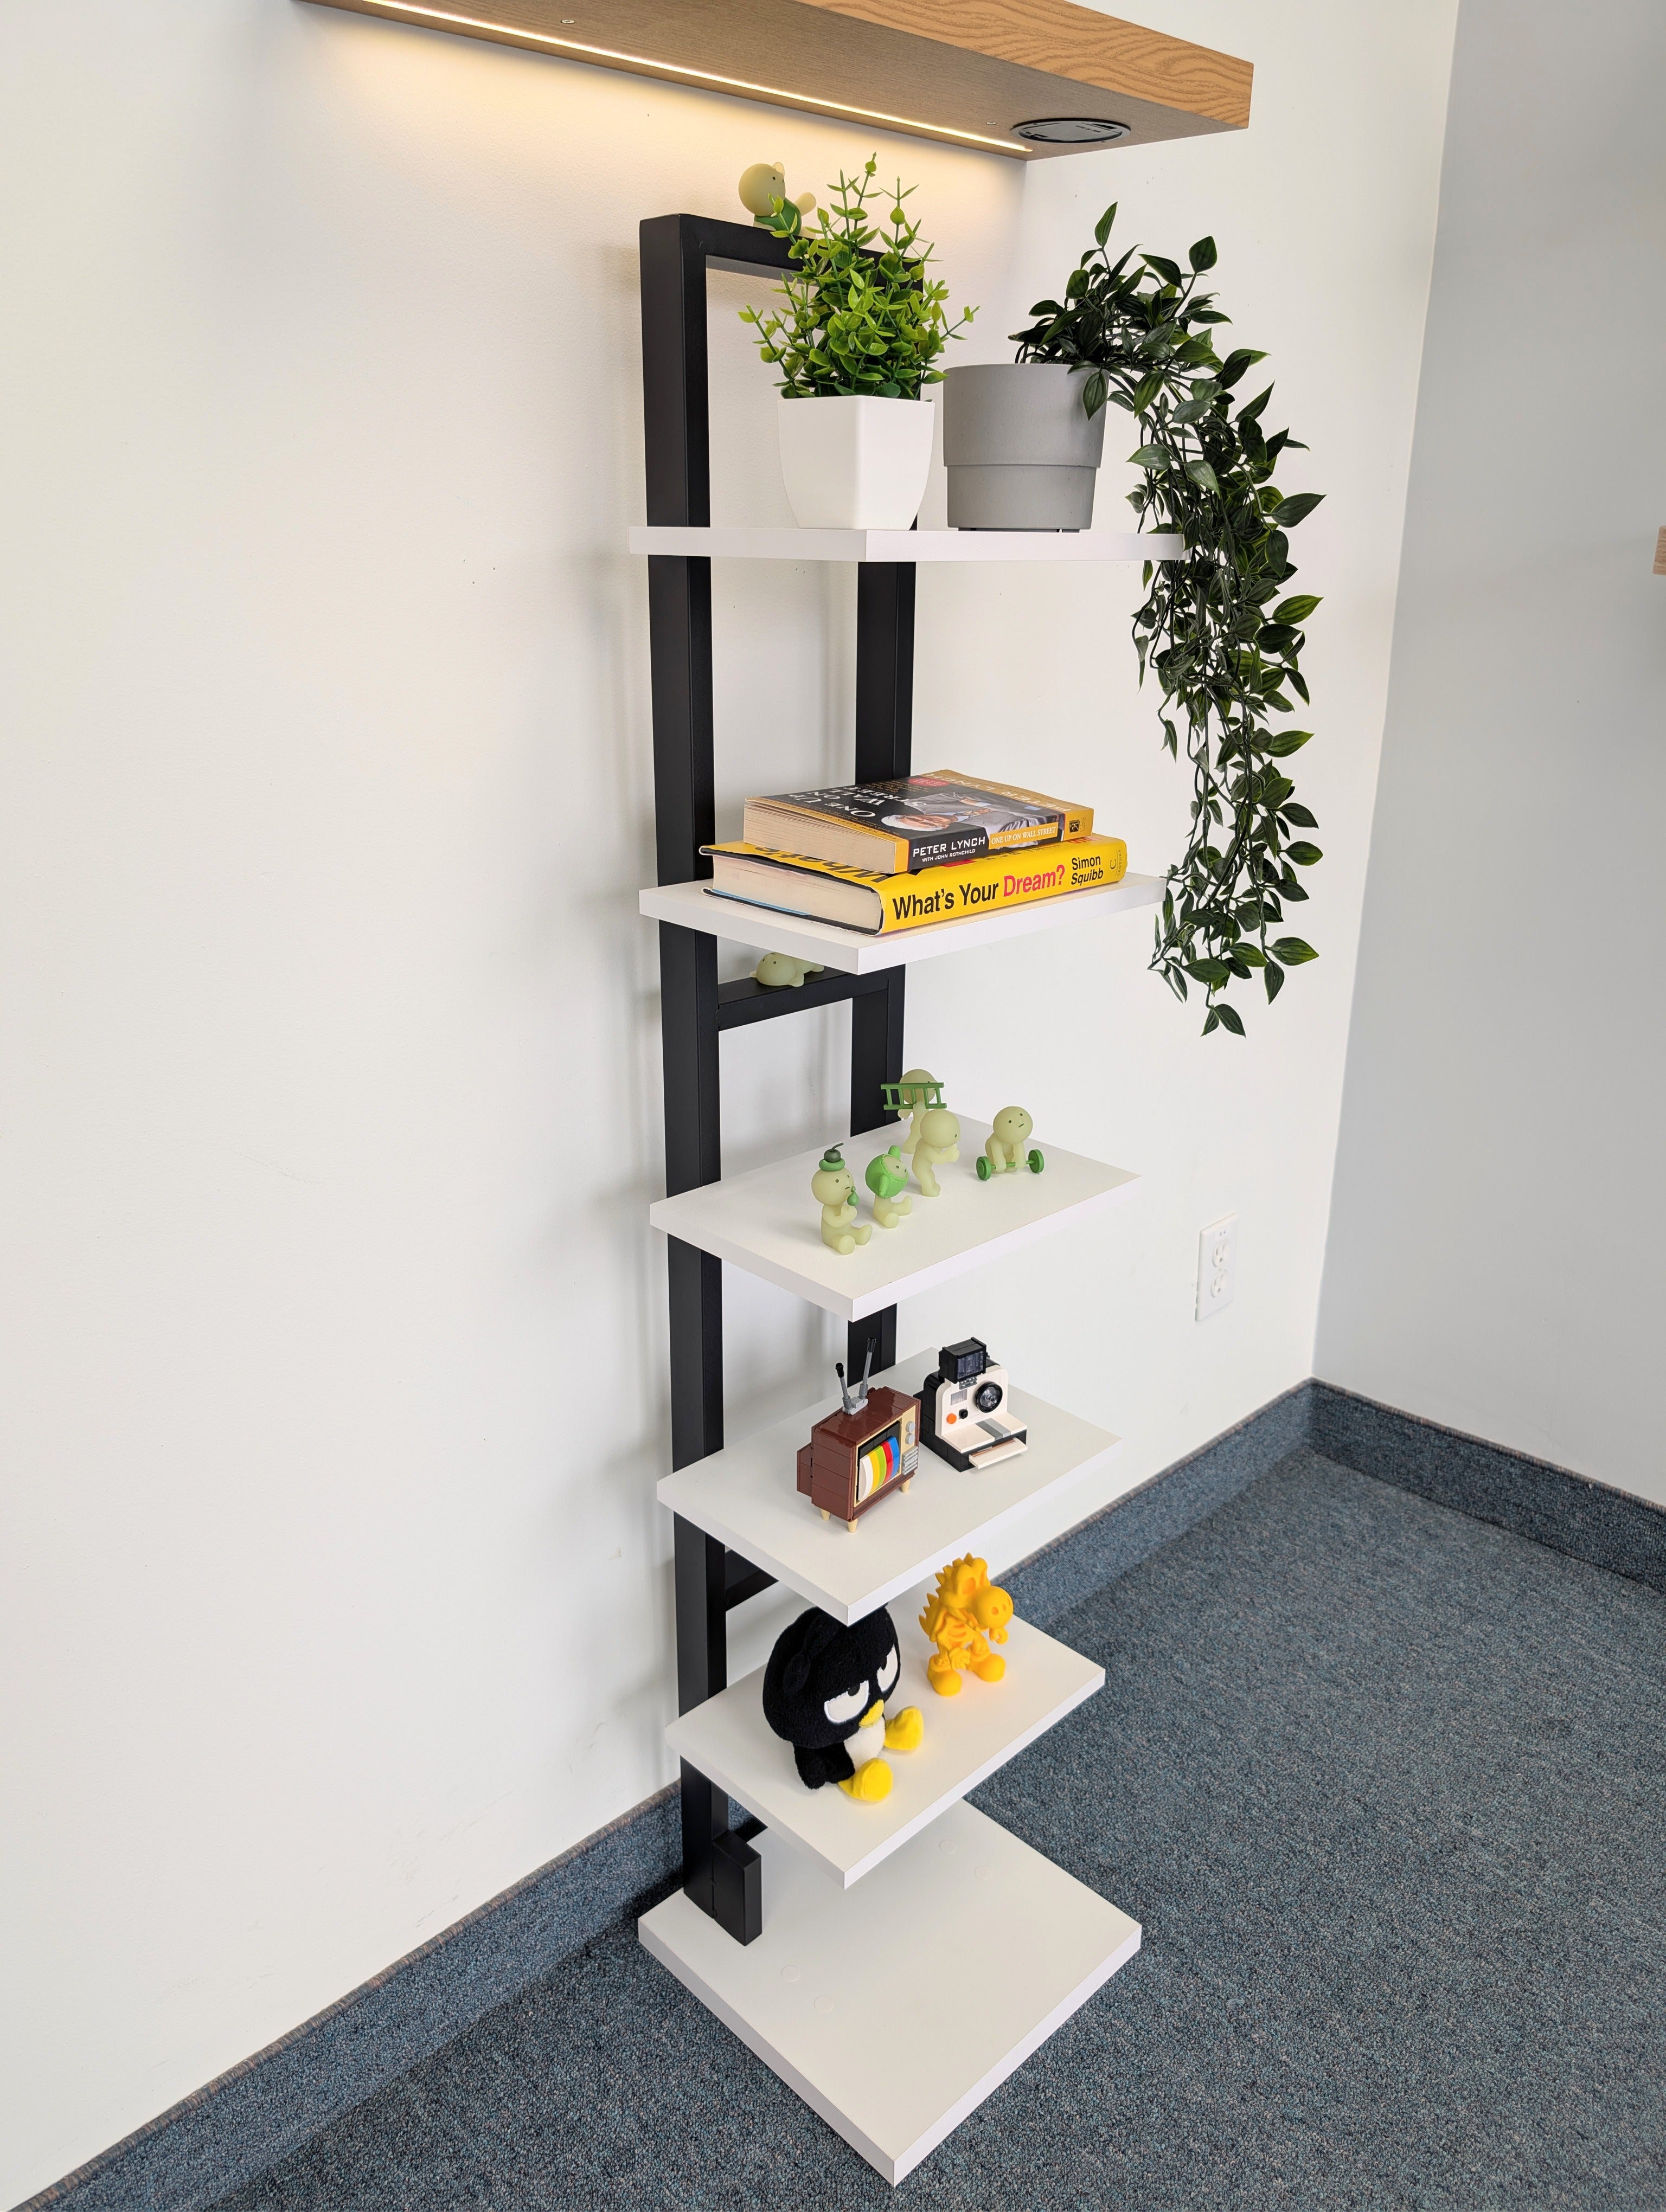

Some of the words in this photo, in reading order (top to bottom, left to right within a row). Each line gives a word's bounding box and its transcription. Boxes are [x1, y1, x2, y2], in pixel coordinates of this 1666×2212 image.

[924, 774, 995, 790] LYNCH
[789, 794, 822, 803] UP
[829, 789, 885, 806] WALL
[843, 787, 927, 807] STREET
[1001, 791, 1072, 812] PETER
[824, 803, 876, 817] ONE
[991, 835, 1003, 845] ONE
[1004, 834, 1012, 843] UP
[1013, 833, 1022, 841] ON
[1022, 830, 1036, 839] WALL
[1037, 827, 1056, 837] STREET
[913, 845, 946, 857] PETER
[952, 836, 985, 850] LYNCH
[949, 849, 976, 859] ROTHCHILD
[1072, 856, 1101, 871] Simon
[1071, 868, 1104, 886] Squibb
[892, 888, 954, 920] What's
[959, 883, 999, 906] Your
[1003, 864, 1065, 897] Dream?
